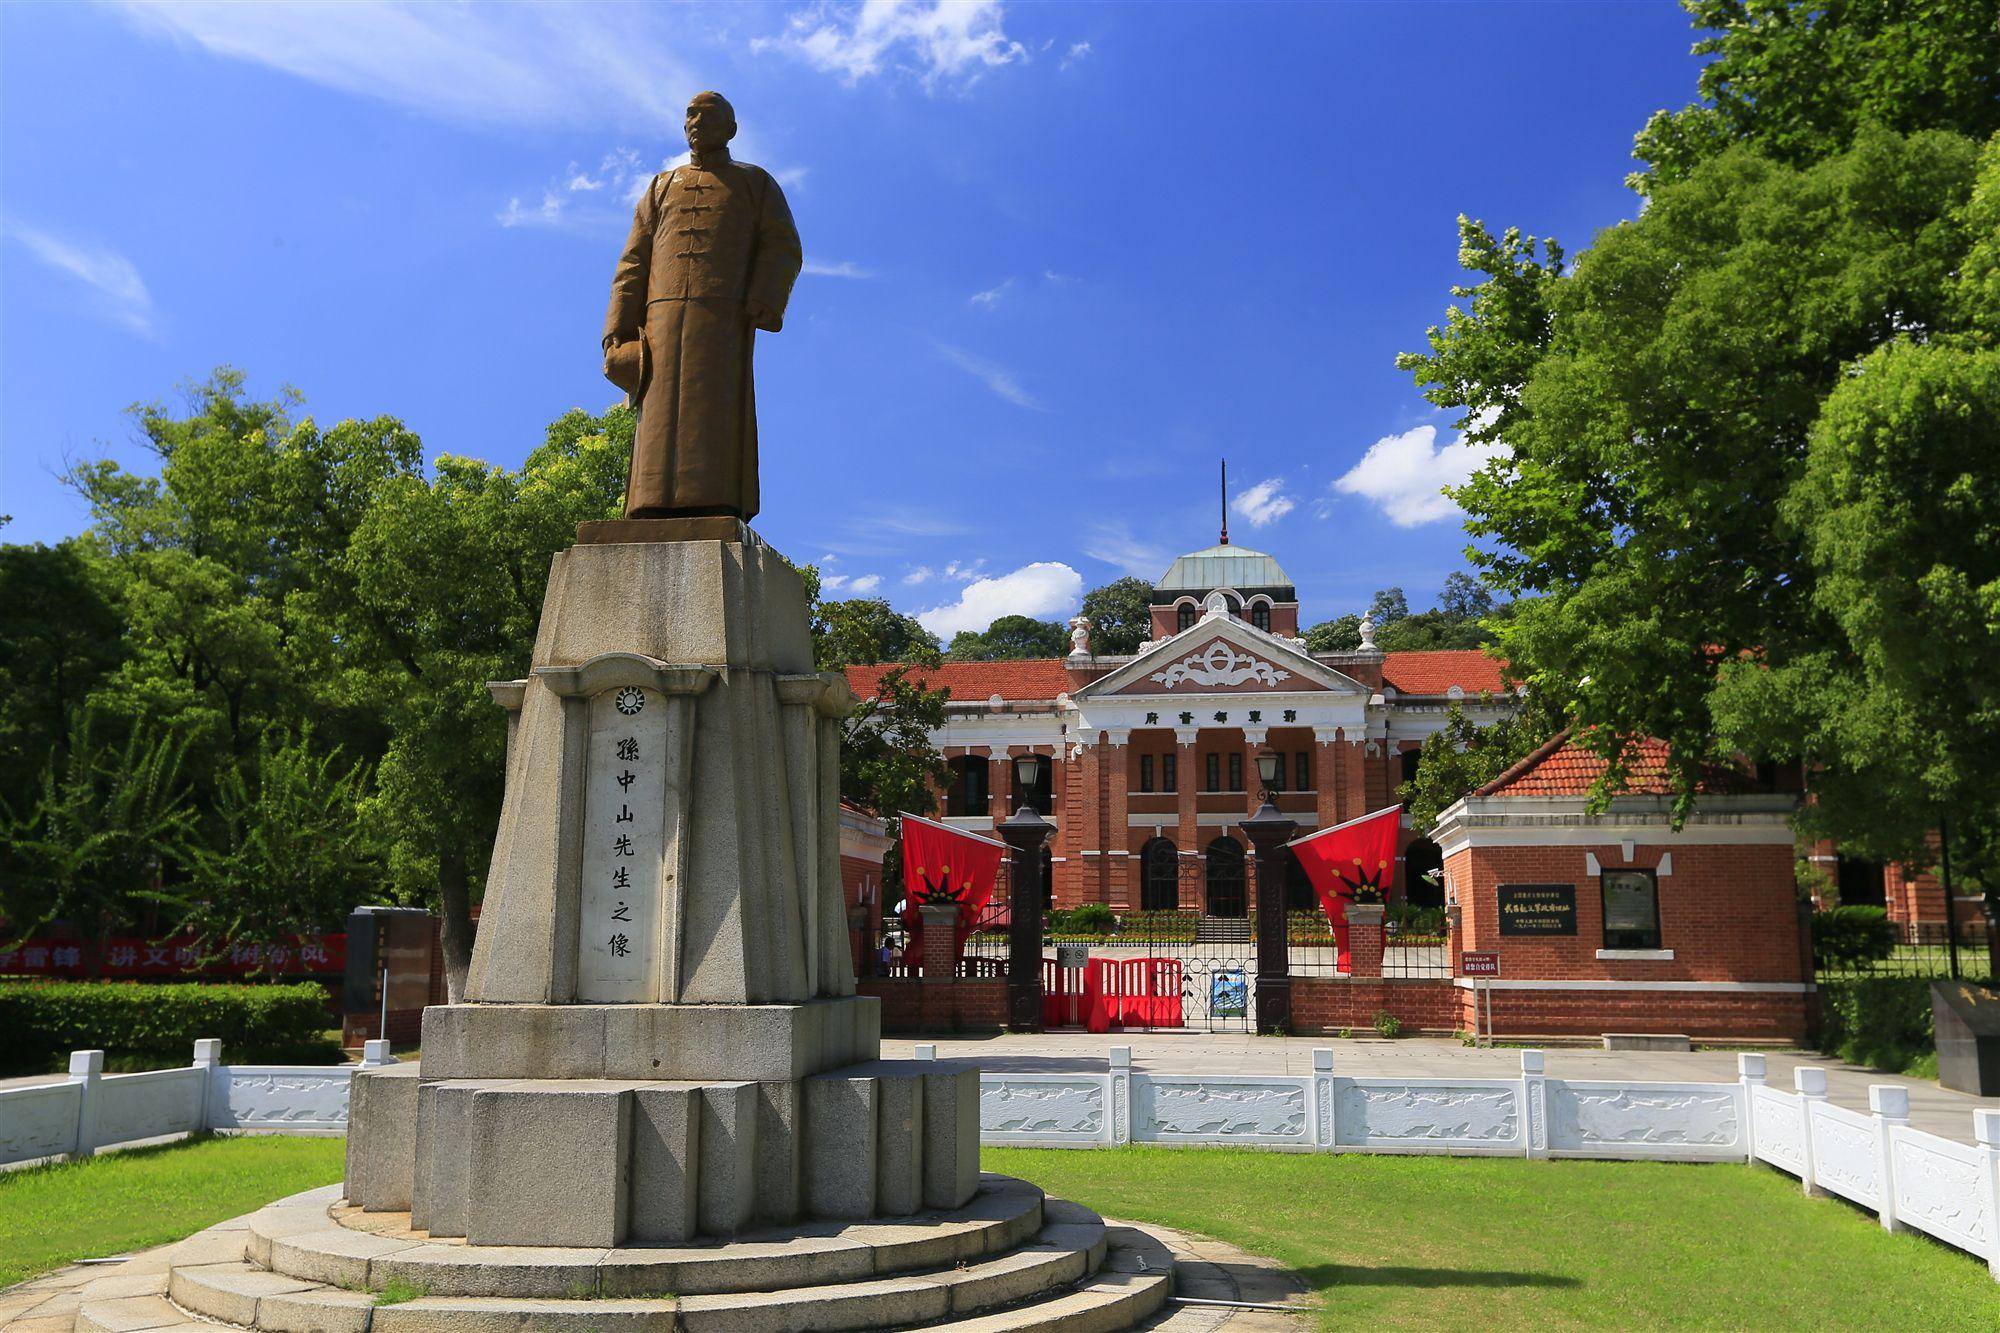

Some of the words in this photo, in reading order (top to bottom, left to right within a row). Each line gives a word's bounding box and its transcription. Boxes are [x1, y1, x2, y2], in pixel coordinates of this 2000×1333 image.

[608, 736, 640, 958] 孫中山先生之像
